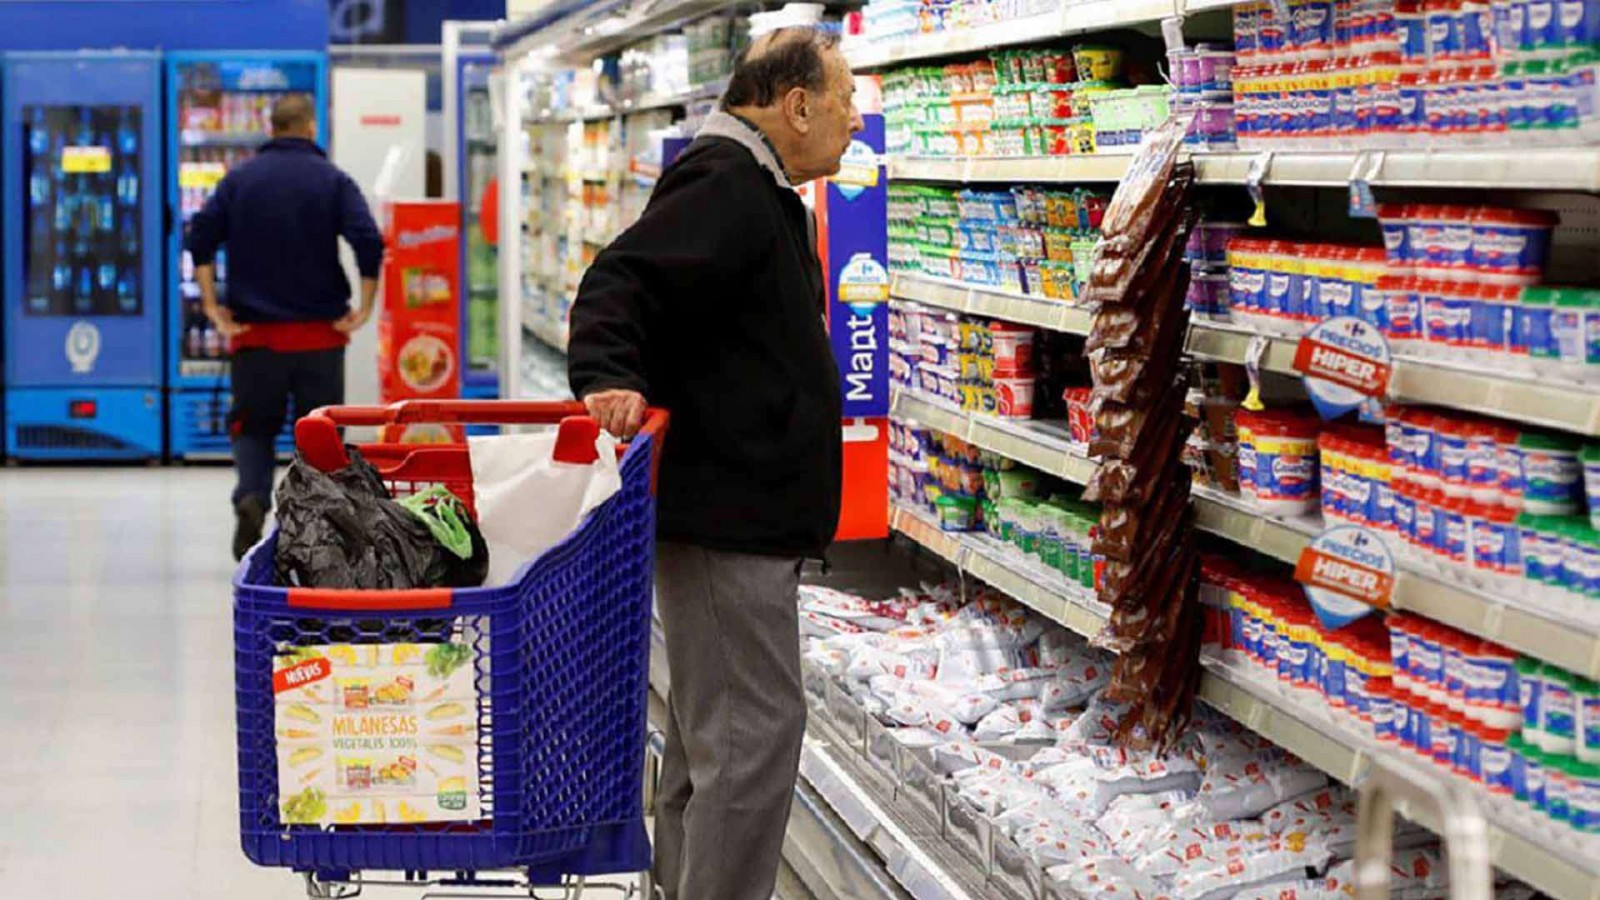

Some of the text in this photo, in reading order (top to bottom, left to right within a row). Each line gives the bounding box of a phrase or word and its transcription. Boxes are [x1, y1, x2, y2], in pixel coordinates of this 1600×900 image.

[1320, 328, 1382, 357] PRECIOS
[1311, 347, 1375, 380] HIPER
[1322, 538, 1385, 569] PRECIOS
[1313, 557, 1377, 590] HIPER
[285, 662, 322, 685] NUEVAS
[332, 715, 418, 736] MILANESAS
[333, 738, 417, 749] VEGETALES 100%
